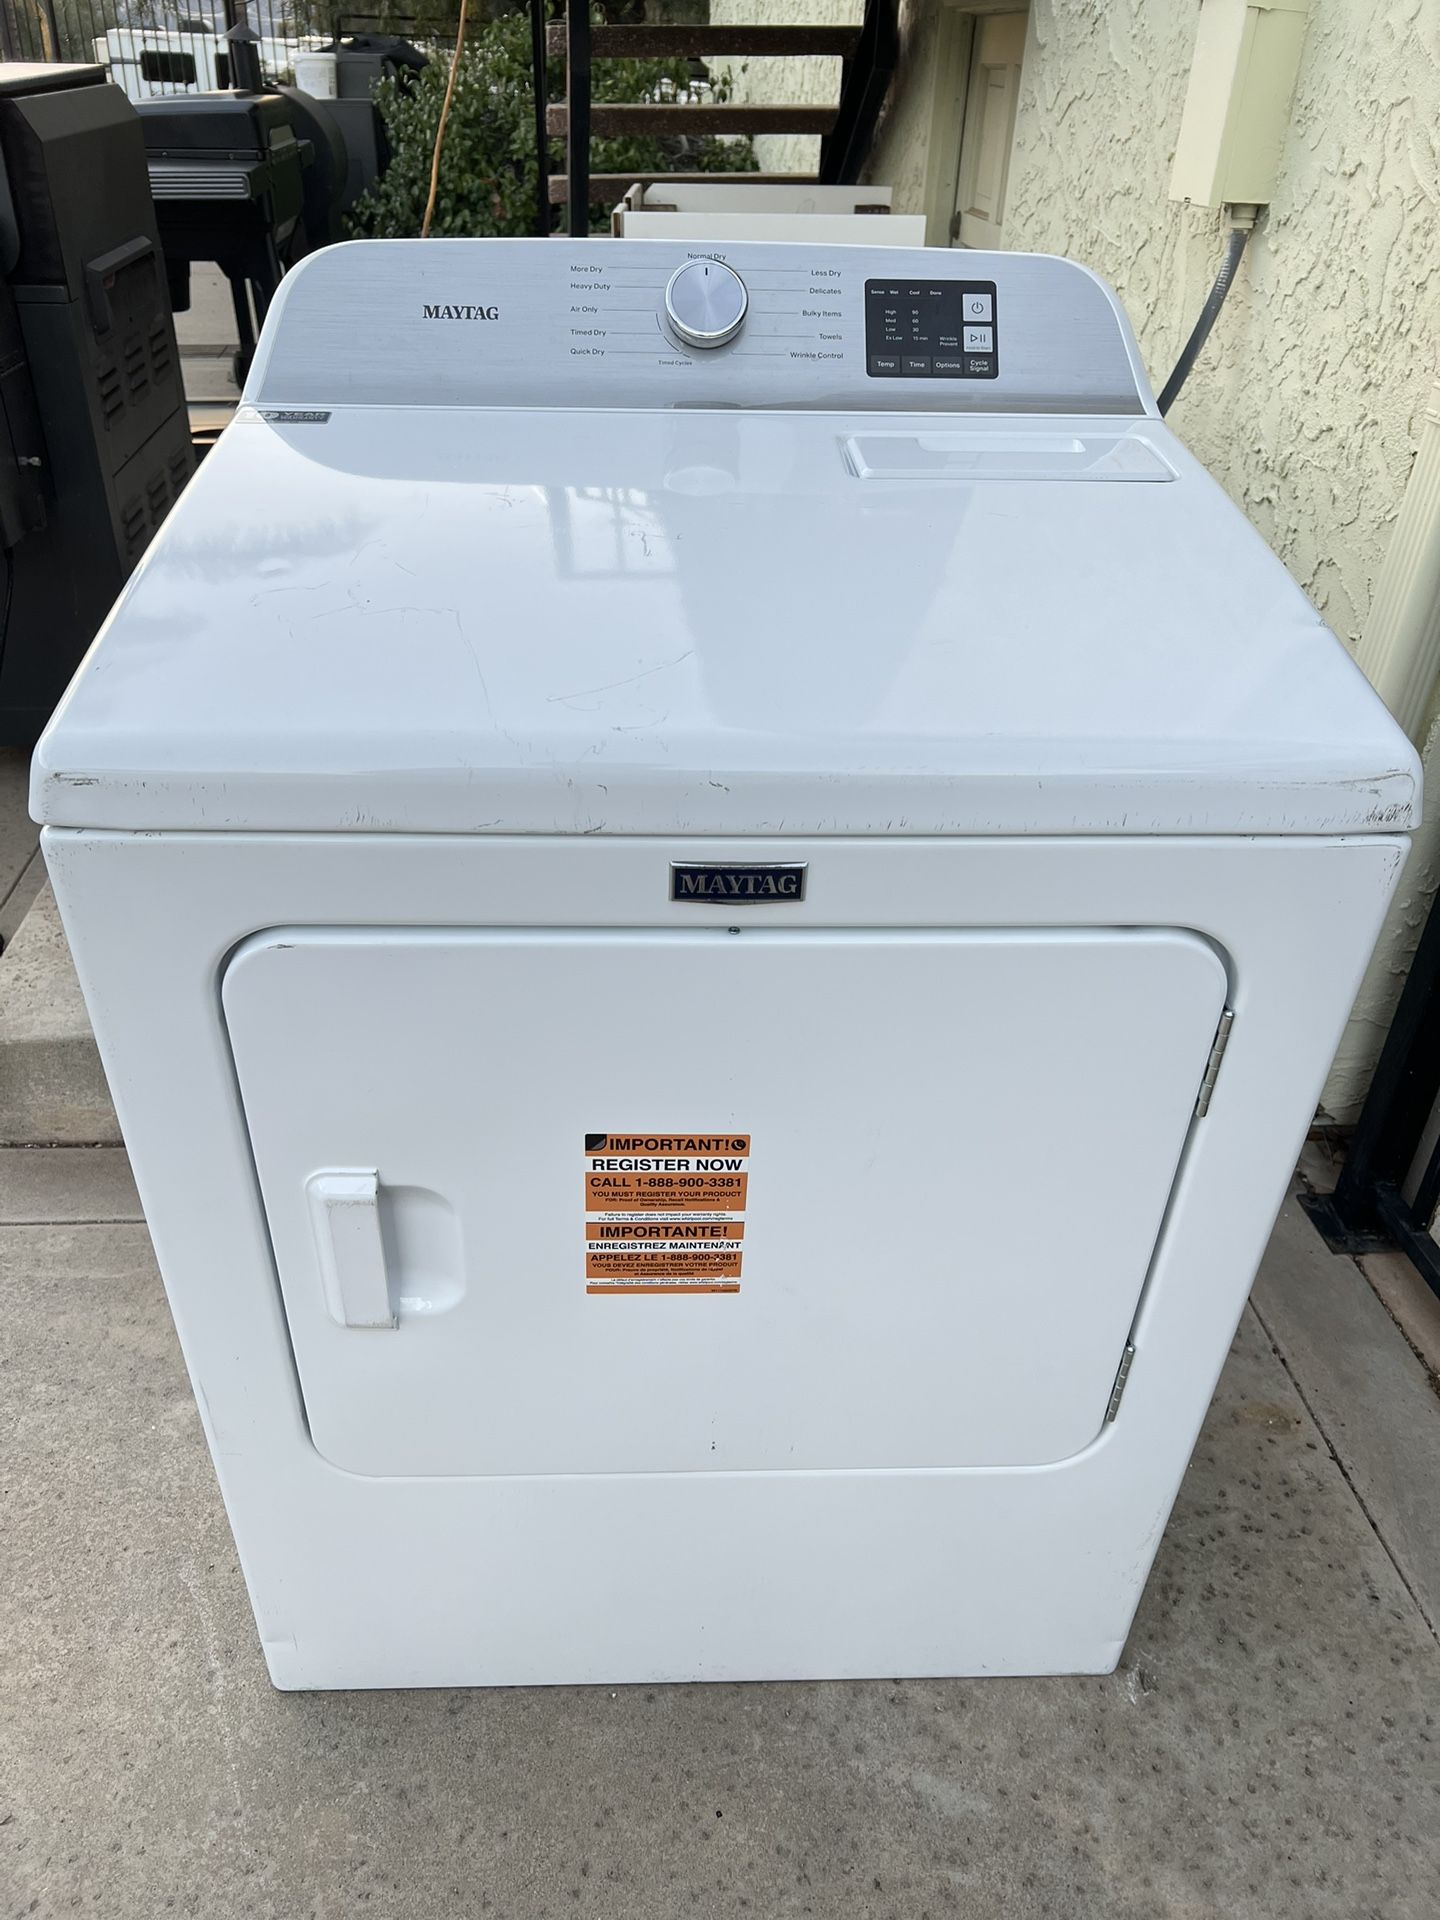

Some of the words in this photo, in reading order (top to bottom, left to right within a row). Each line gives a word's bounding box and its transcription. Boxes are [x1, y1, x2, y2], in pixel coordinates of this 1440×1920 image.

[811, 269, 828, 277] Less
[829, 270, 841, 278] Dry
[809, 287, 842, 295] Delicates
[422, 304, 500, 321] MAYTAG
[582, 306, 598, 314] Only
[802, 309, 821, 317] Bulky
[790, 351, 817, 359] Wrinkle
[877, 361, 895, 369] Temp
[970, 359, 988, 367] Cycle
[969, 365, 989, 373] Signal
[679, 873, 799, 895] MAYTAG
[609, 1138, 730, 1151] IMPORTANT!
[592, 1158, 690, 1171] REGISTER
[696, 1159, 743, 1171] NOW
[590, 1177, 632, 1188] CALL
[635, 1177, 742, 1188] 1-888-900-3381
[600, 1226, 728, 1238] IMPORTANTE!
[588, 1242, 667, 1250] ENREGISTREZ
[669, 1241, 742, 1250] MAINTENANT
[661, 1253, 737, 1261] 1-888-900-3381
